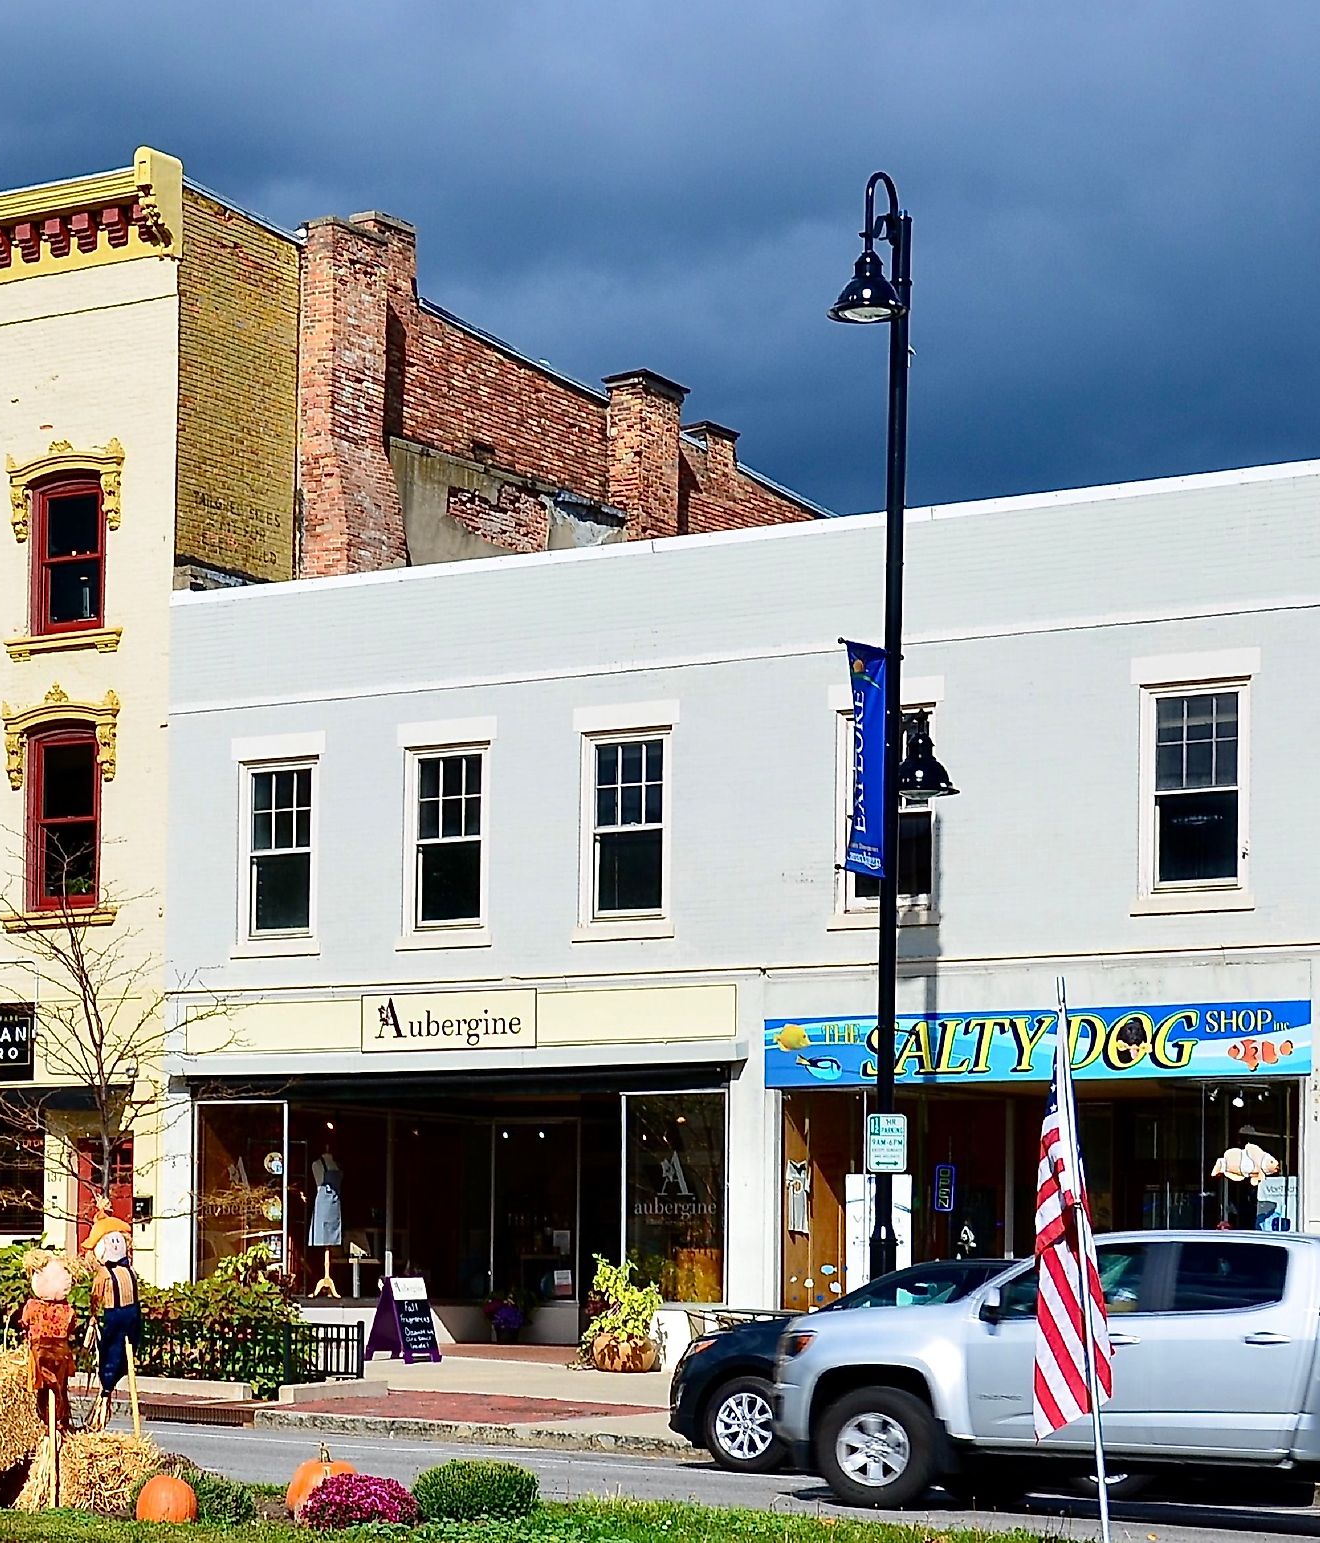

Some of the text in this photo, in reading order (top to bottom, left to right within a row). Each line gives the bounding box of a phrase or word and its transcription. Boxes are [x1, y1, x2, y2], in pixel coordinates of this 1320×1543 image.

[374, 997, 522, 1046] Aubergine
[821, 1023, 861, 1045] THE
[861, 1016, 1056, 1076] SALTY
[1066, 1010, 1198, 1072] DOG
[1204, 1009, 1274, 1033] SHOP
[633, 1196, 717, 1220] aubergine
[938, 1168, 951, 1208] OPEN
